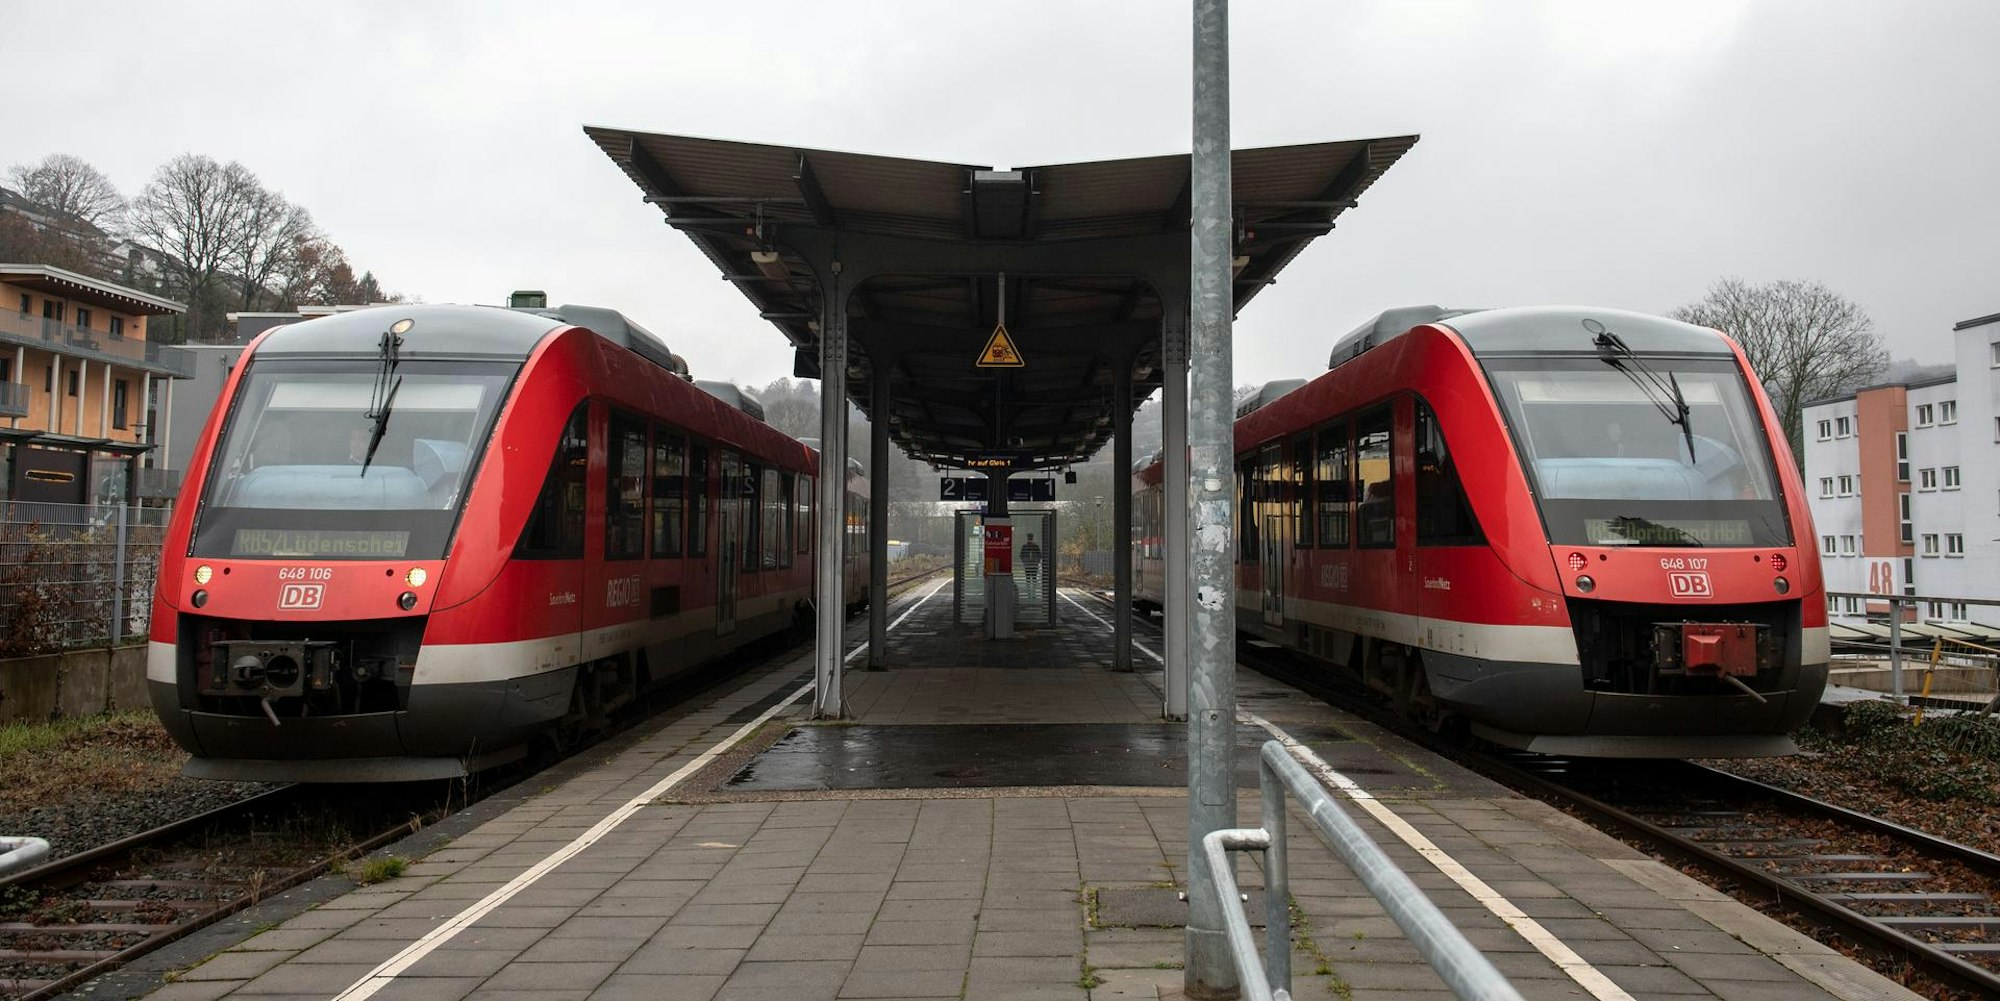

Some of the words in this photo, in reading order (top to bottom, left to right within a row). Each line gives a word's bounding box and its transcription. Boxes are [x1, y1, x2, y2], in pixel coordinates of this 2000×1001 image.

[944, 479, 955, 495] 2
[1045, 480, 1053, 496] 1
[1660, 558, 1684, 570] 648
[1688, 558, 1708, 570] 107
[279, 567, 305, 580] 648
[309, 567, 332, 580] 106
[1869, 561, 1893, 595] 48
[607, 577, 631, 608] REGIO
[1671, 574, 1710, 595] DB
[281, 585, 323, 608] DB
